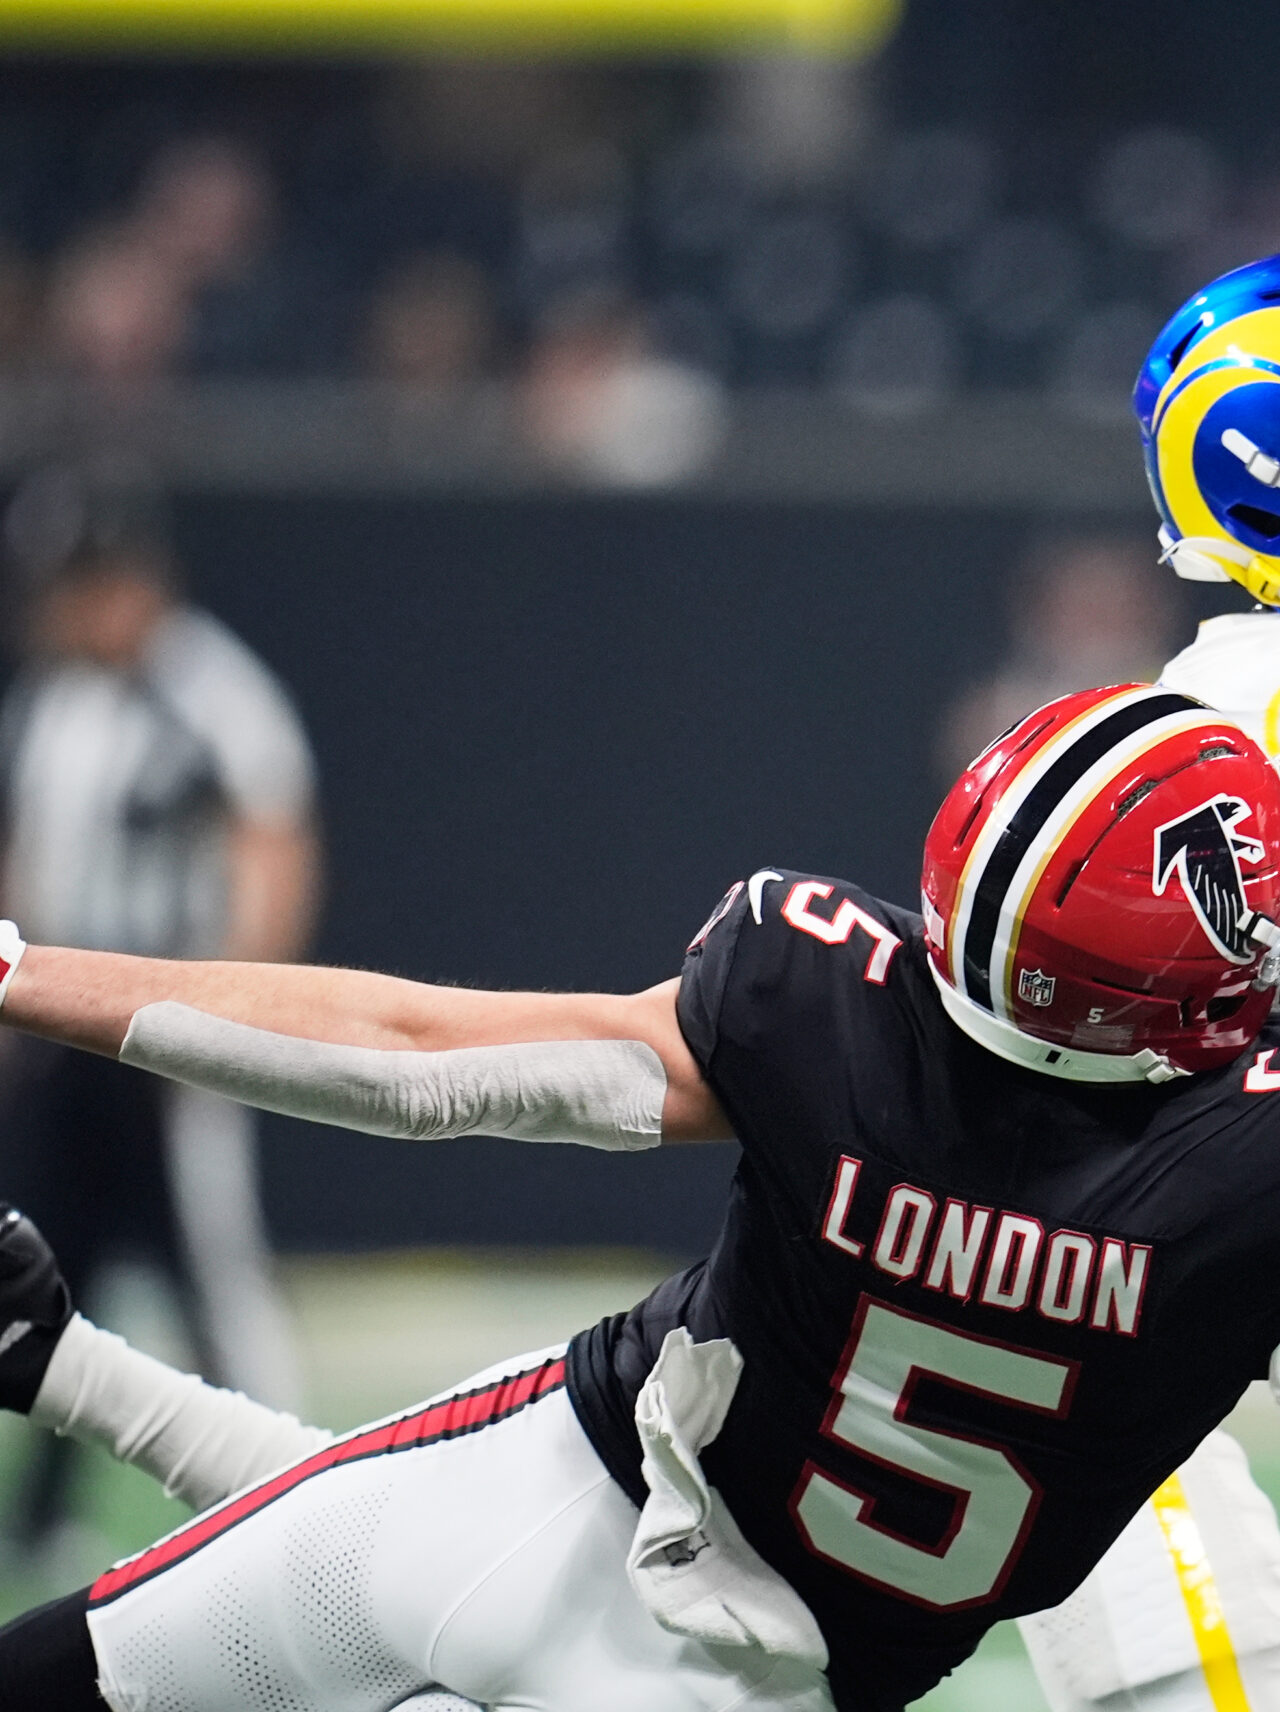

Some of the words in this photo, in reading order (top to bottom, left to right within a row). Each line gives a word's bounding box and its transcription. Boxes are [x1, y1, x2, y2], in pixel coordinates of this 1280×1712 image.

[780, 880, 903, 986] 5
[1022, 983, 1051, 1002] NFL
[1087, 1007, 1104, 1023] 5
[822, 1154, 1153, 1338] LONDON
[787, 1291, 1082, 1613] 5
